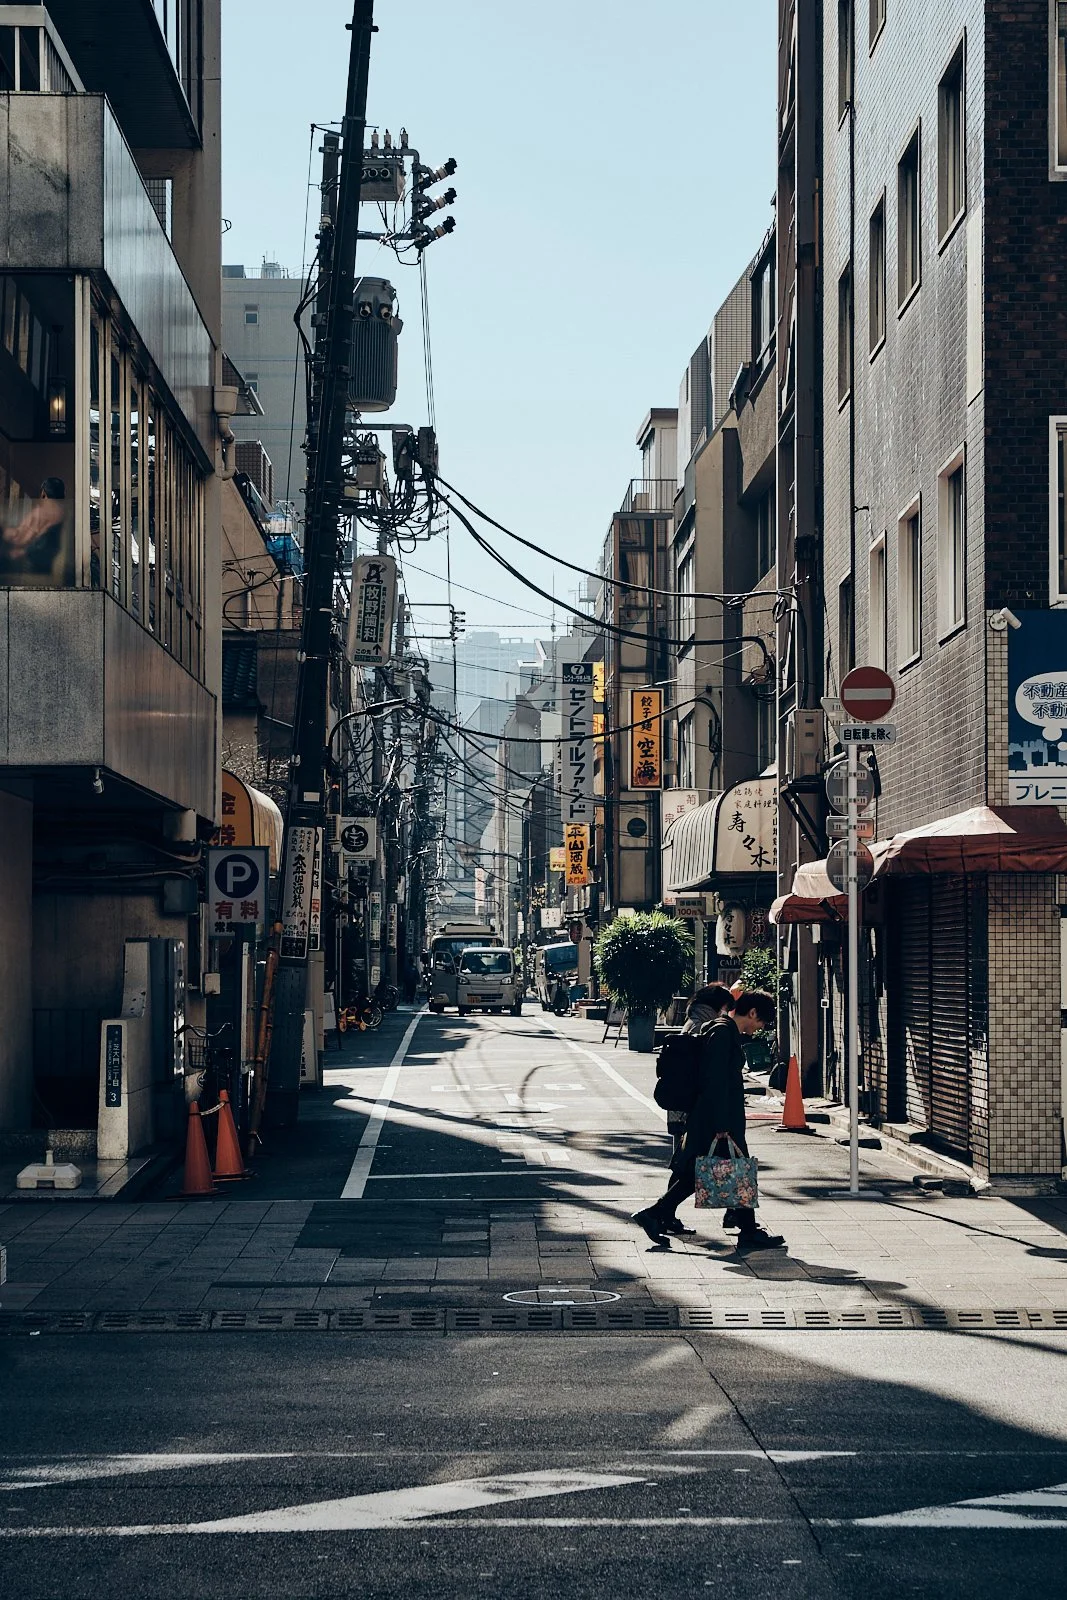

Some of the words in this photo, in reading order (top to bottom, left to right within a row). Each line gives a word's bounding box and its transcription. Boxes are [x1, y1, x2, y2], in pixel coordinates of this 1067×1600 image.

[364, 586, 380, 641] 牧野歯科
[1033, 703, 1067, 719] 不動
[844, 728, 890, 740] 自転車を除く
[570, 688, 586, 818] セントラルファンド
[637, 738, 656, 780] 空海
[226, 862, 251, 893] P
[215, 900, 259, 919] 有料
[110, 1092, 117, 1102] 3
